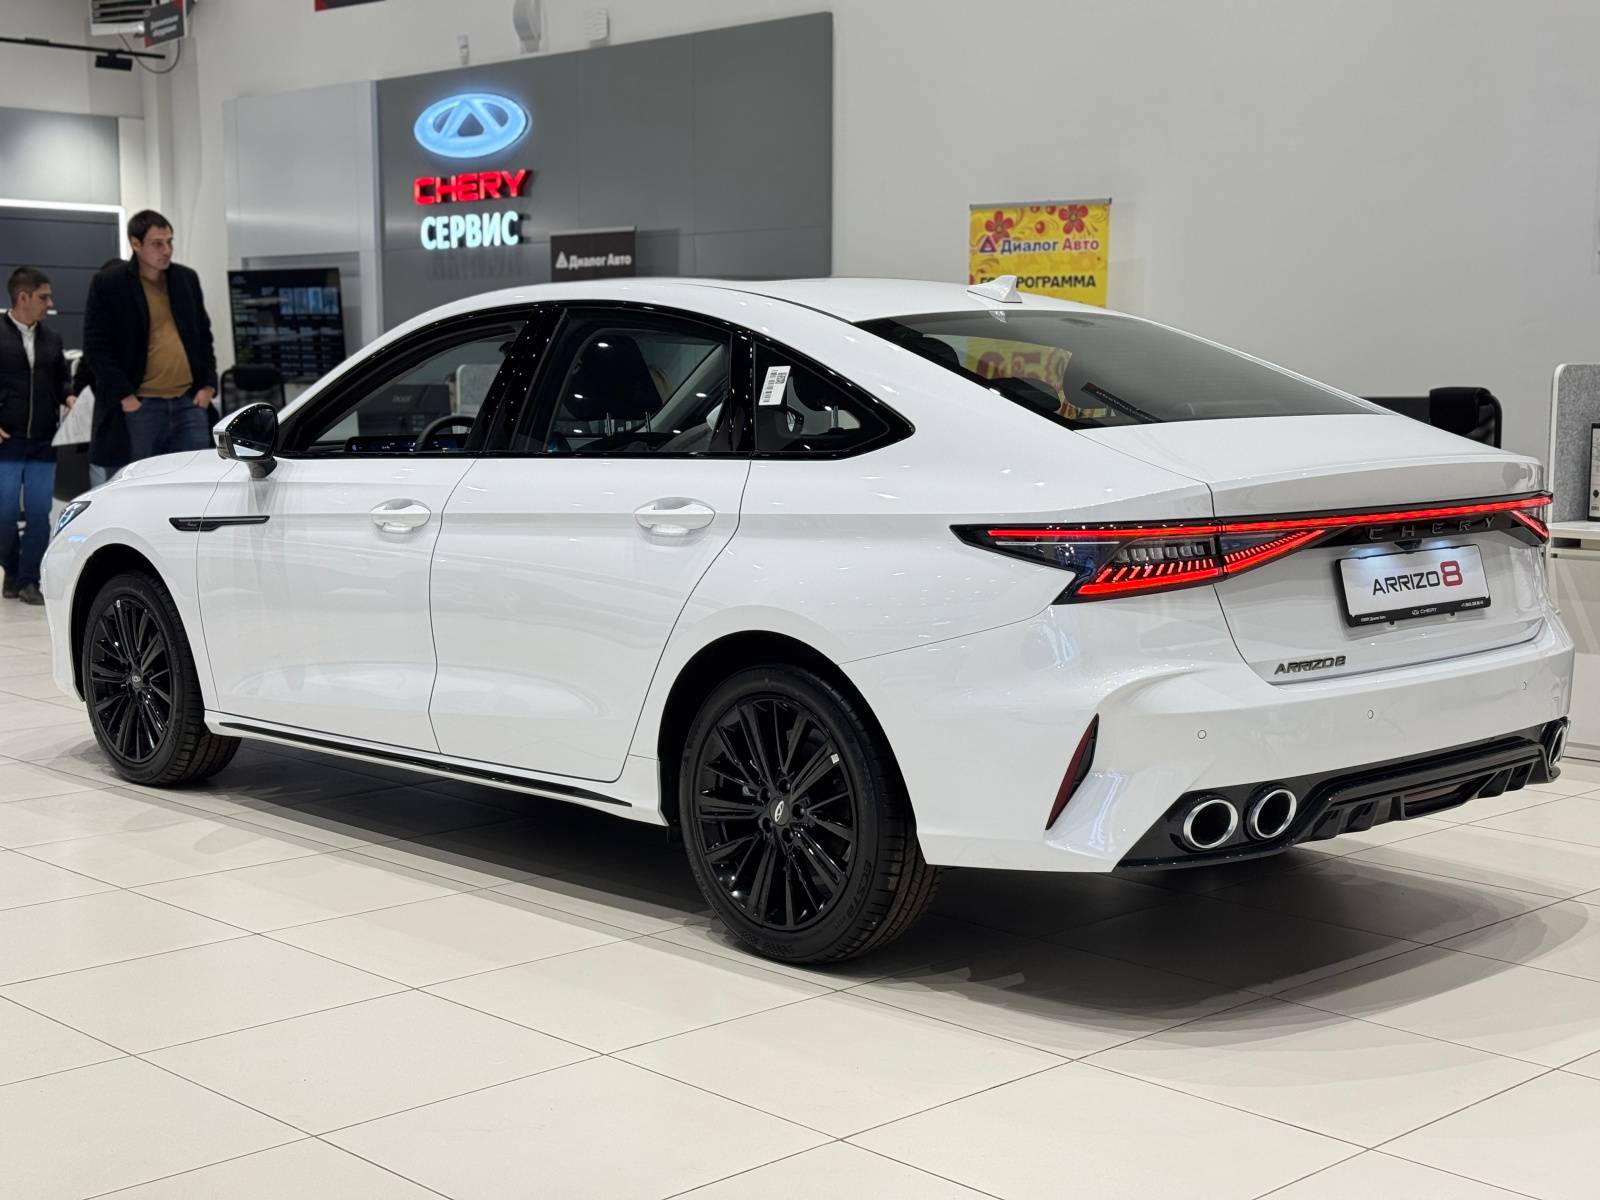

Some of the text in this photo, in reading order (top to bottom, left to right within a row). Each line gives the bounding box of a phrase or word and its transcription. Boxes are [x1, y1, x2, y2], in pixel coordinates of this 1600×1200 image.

[415, 169, 526, 205] CHERY
[420, 210, 519, 250] СЕРВИС
[1001, 238, 1100, 254] Диалог Авто
[568, 253, 632, 270] Диалог Авто
[1368, 517, 1496, 541] CHERY
[1372, 560, 1463, 596] ARRIZO 8
